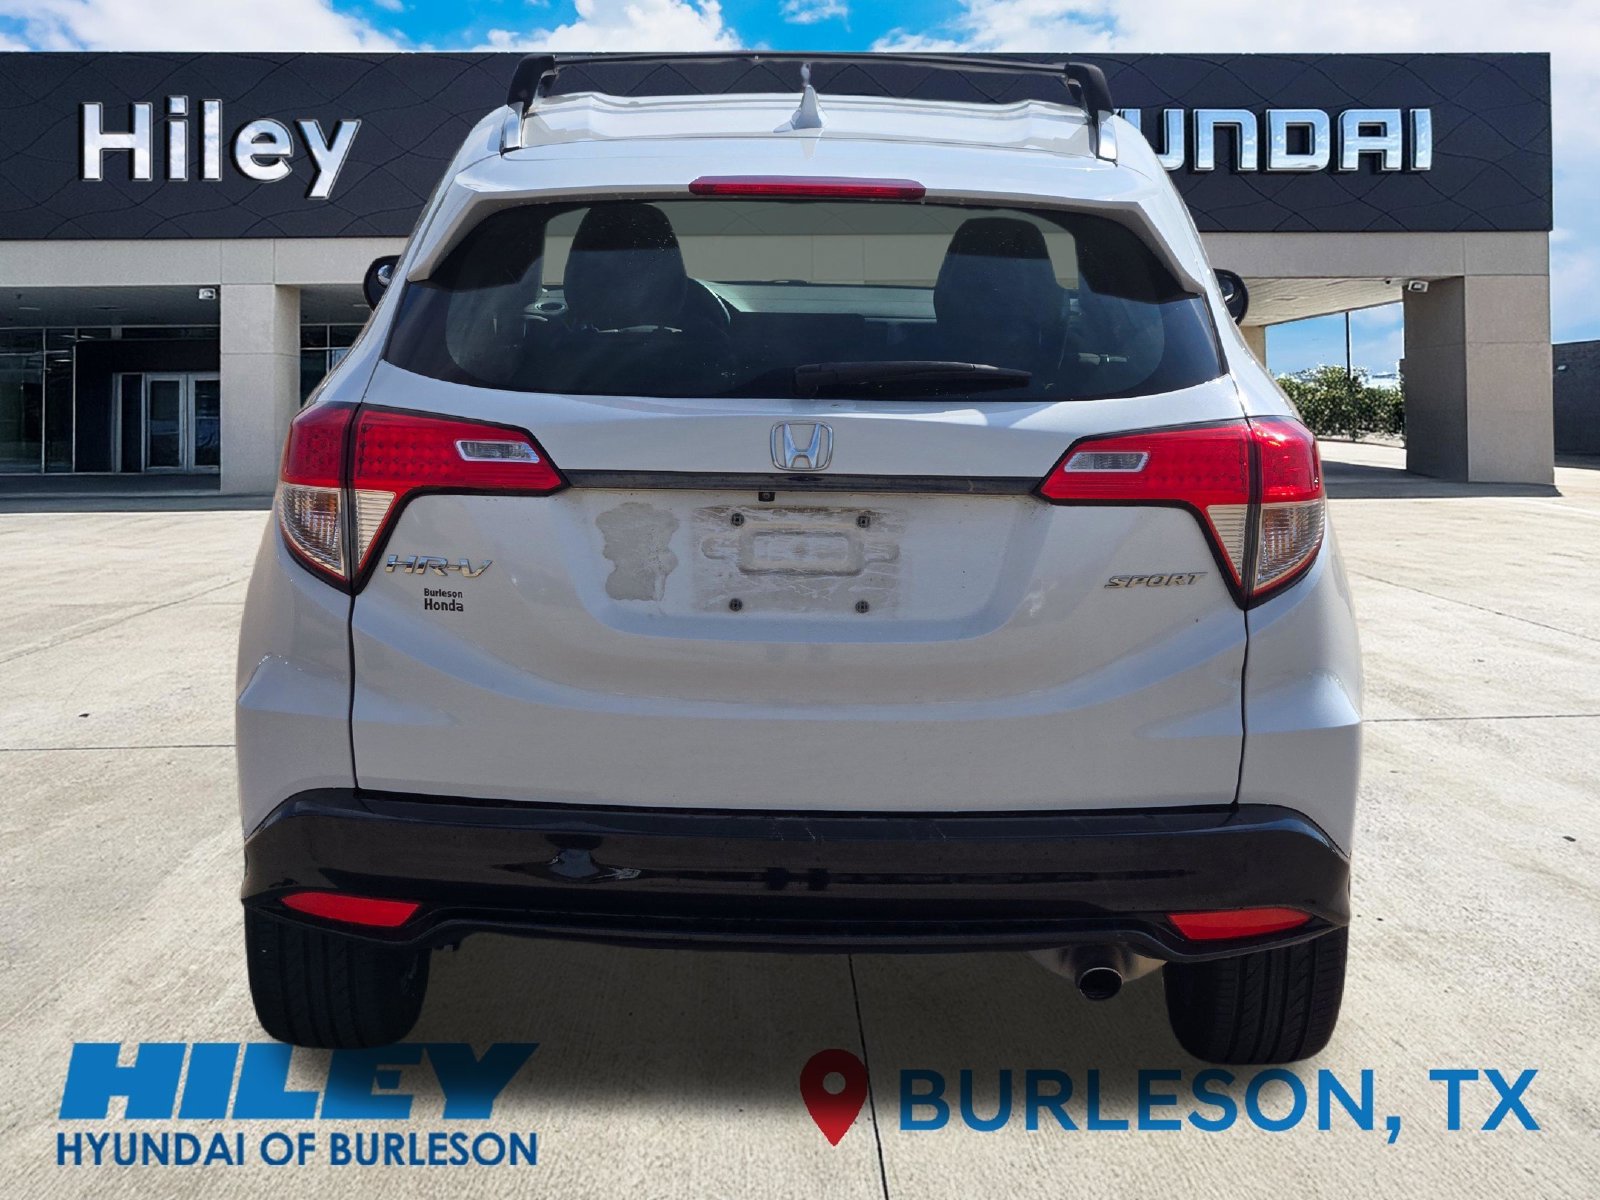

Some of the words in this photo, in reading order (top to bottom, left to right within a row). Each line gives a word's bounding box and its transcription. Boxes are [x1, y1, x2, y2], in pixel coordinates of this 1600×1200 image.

[80, 95, 362, 200] Hiley
[1113, 107, 1433, 171] UNDAI
[385, 554, 493, 578] HR-V
[1104, 571, 1208, 589] SPORT
[423, 587, 464, 599] Burleson
[423, 598, 464, 612] Honda
